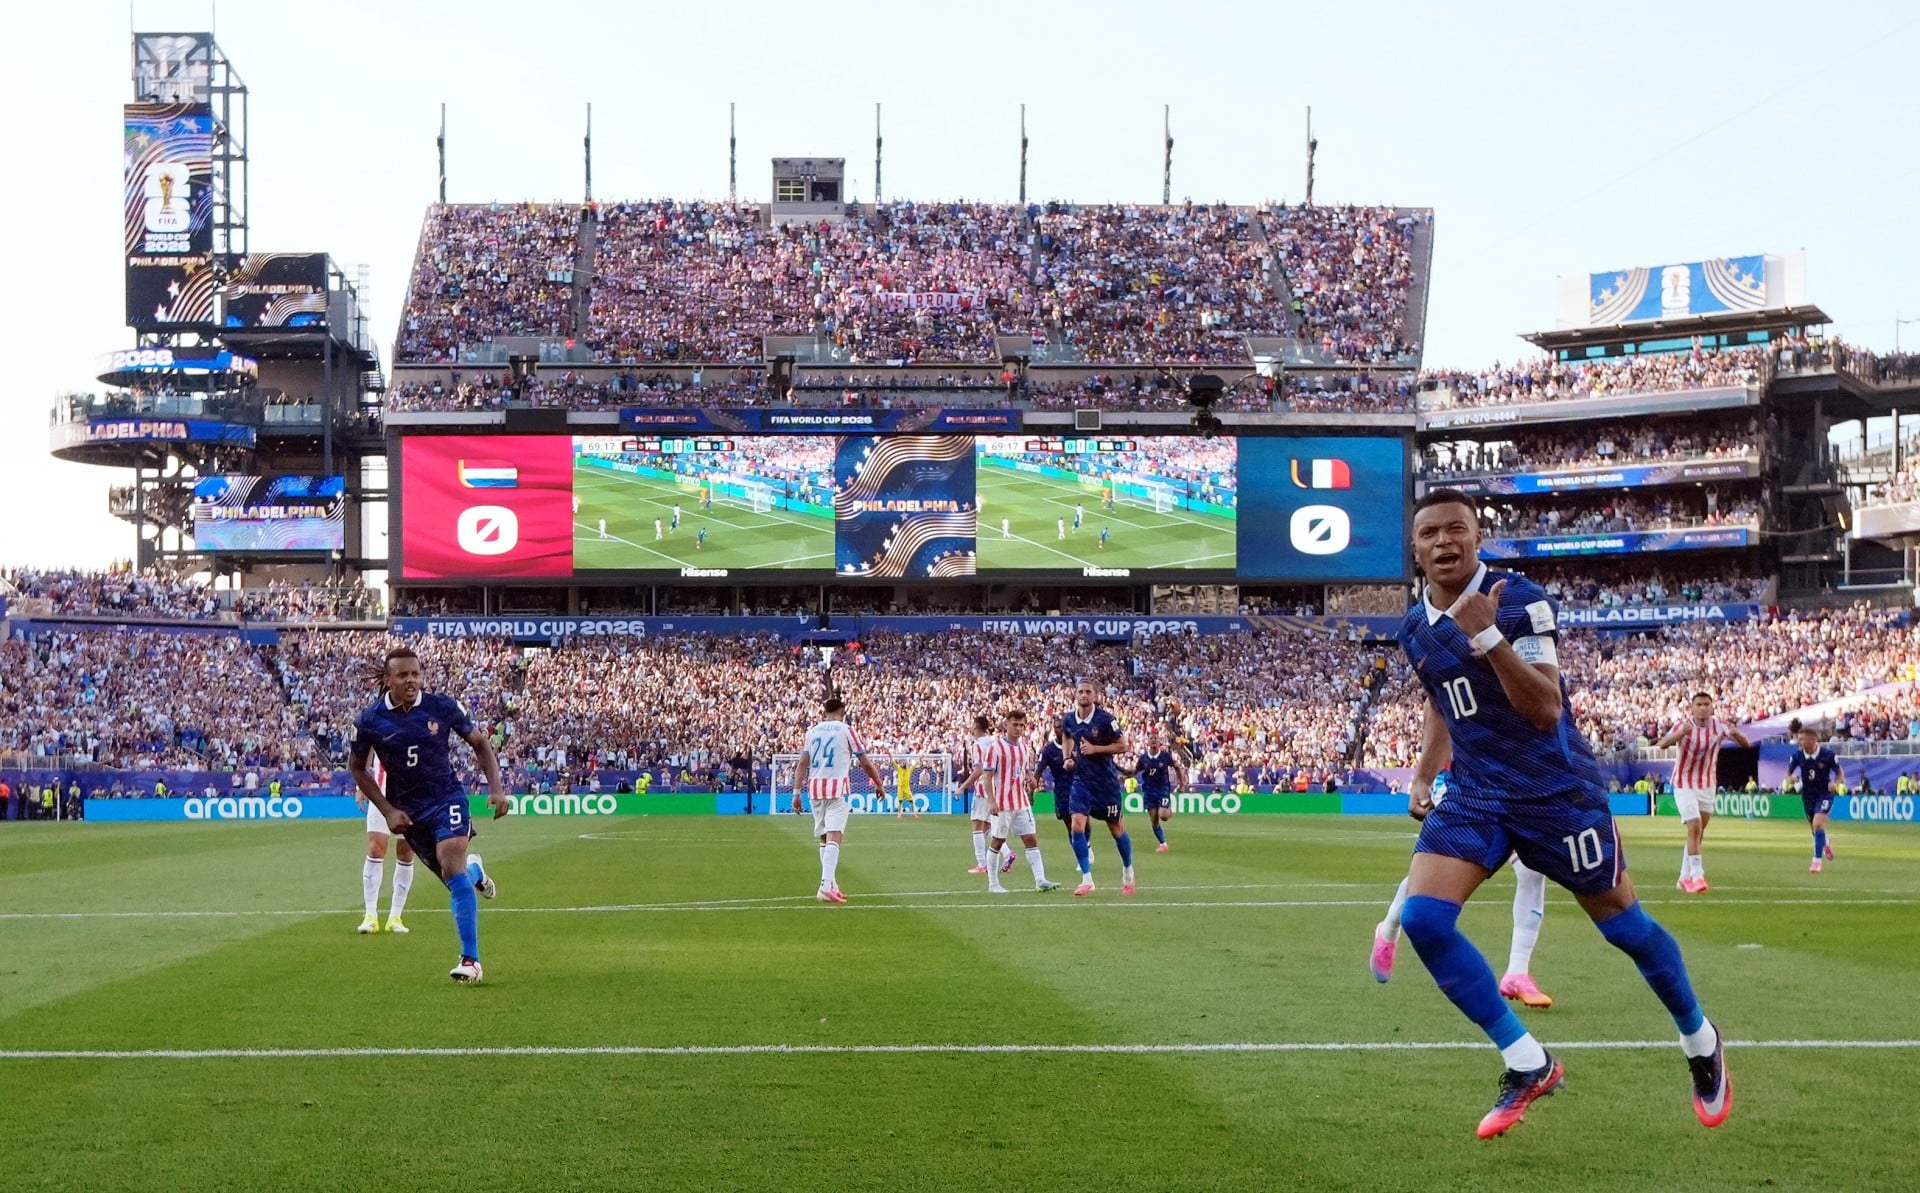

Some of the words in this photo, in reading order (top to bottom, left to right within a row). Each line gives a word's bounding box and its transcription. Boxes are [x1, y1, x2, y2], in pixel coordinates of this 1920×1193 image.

[145, 233, 173, 241] WORLD
[174, 233, 191, 241] CUP
[145, 240, 191, 252] 2026
[130, 256, 206, 266] PHILADELPHIA
[238, 284, 314, 294] PHILADELPHIA
[113, 350, 173, 368] 2026
[771, 416, 790, 424] FIFA
[791, 416, 823, 424] WORLD
[824, 416, 840, 424] CUP
[841, 416, 872, 424] 2026
[588, 442, 615, 450] 69:17
[991, 442, 1019, 451] 69:17
[211, 506, 327, 519] PHILADELPHIA
[852, 500, 959, 512] PHILADELPHIA
[681, 567, 728, 577] Hisense
[1083, 567, 1130, 577] Hisense
[1557, 605, 1725, 624] PHILADELPHIA
[428, 621, 467, 636] FIFA
[469, 621, 537, 636] WORLD
[540, 621, 578, 636] CUP
[580, 620, 645, 636] 2026
[982, 621, 1019, 635] FIFA
[1023, 621, 1091, 636] WORLD
[1093, 621, 1131, 636] CUP
[1133, 620, 1198, 636] 2026
[1442, 676, 1478, 720] 10
[406, 745, 419, 767] 5
[812, 736, 836, 768] 24
[1808, 769, 1816, 780] 3
[183, 797, 303, 819] aramco
[504, 794, 618, 815] aramco
[1107, 804, 1118, 817] 14
[1715, 794, 1770, 816] aramco
[1850, 795, 1914, 820] aramco
[449, 804, 462, 824] 5
[1562, 827, 1604, 873] 10
